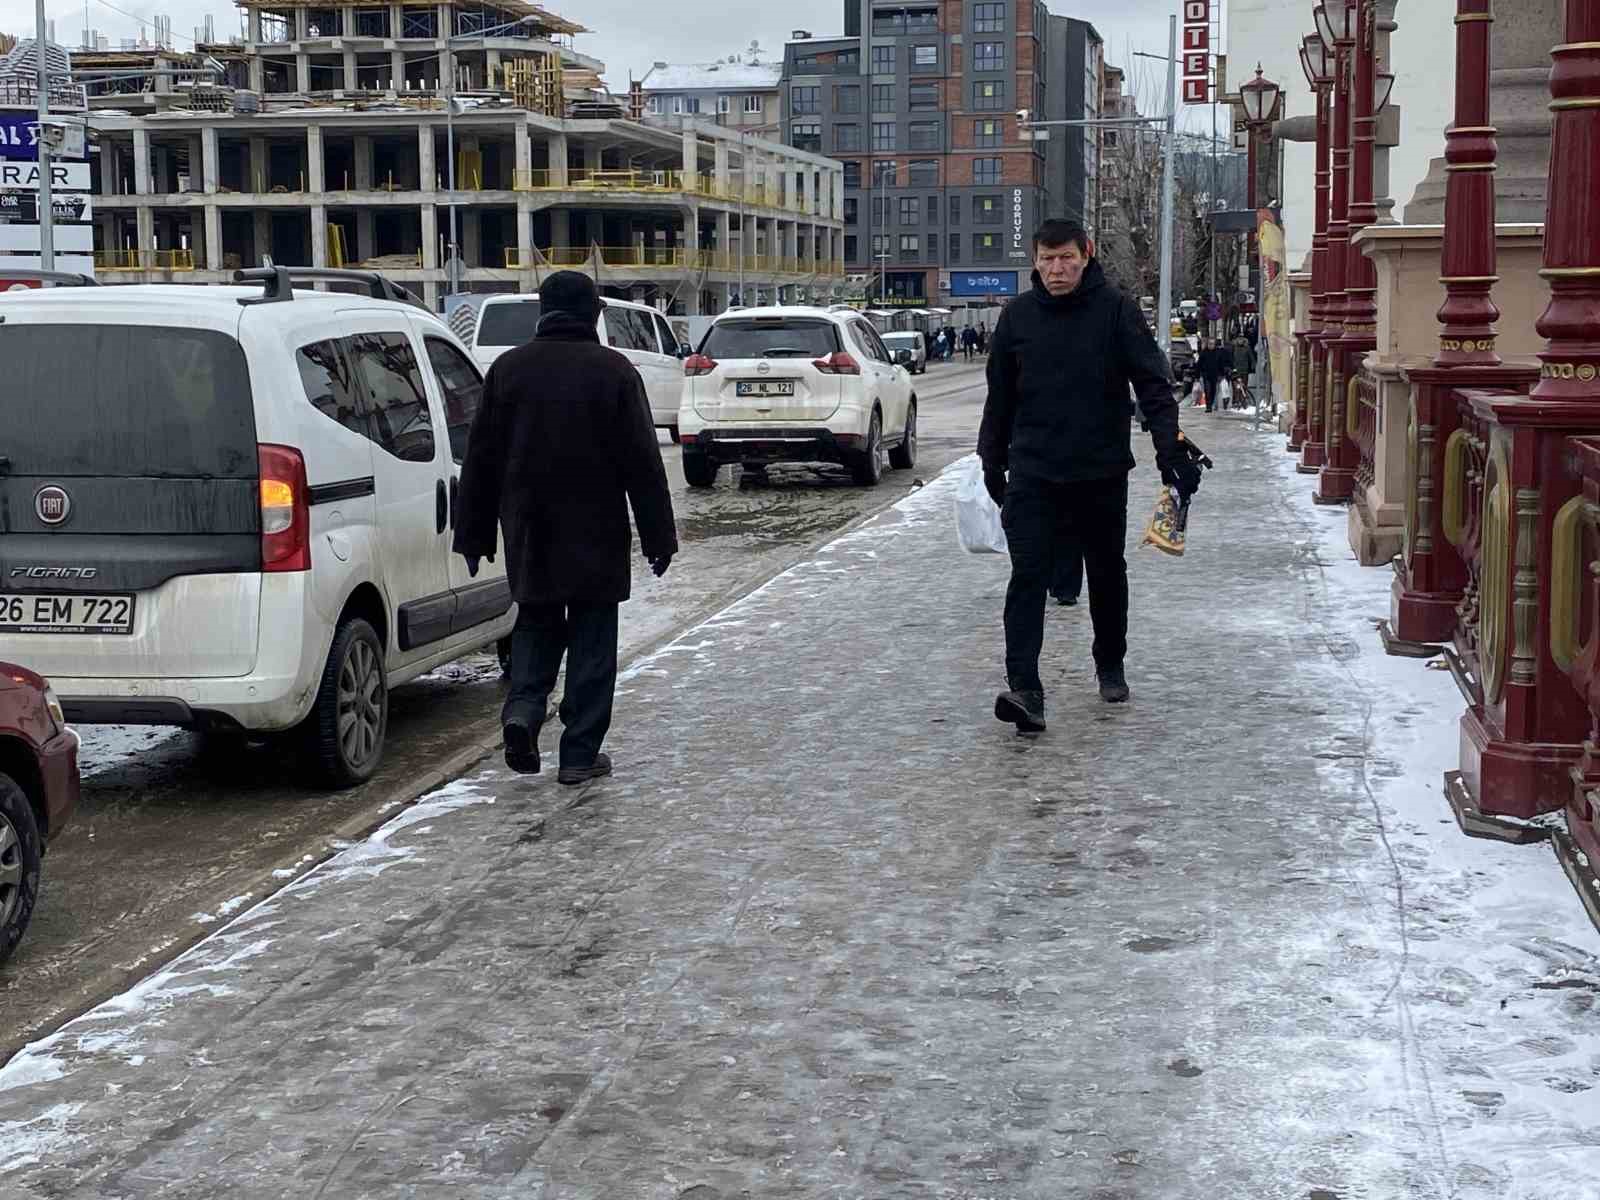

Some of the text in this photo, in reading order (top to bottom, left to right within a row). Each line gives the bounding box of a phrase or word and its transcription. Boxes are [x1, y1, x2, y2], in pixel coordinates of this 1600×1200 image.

[1187, 2, 1205, 99] OTEL
[43, 498, 62, 513] FIAT
[11, 567, 97, 578] FIORINO
[0, 597, 129, 625] 26 EM 722
